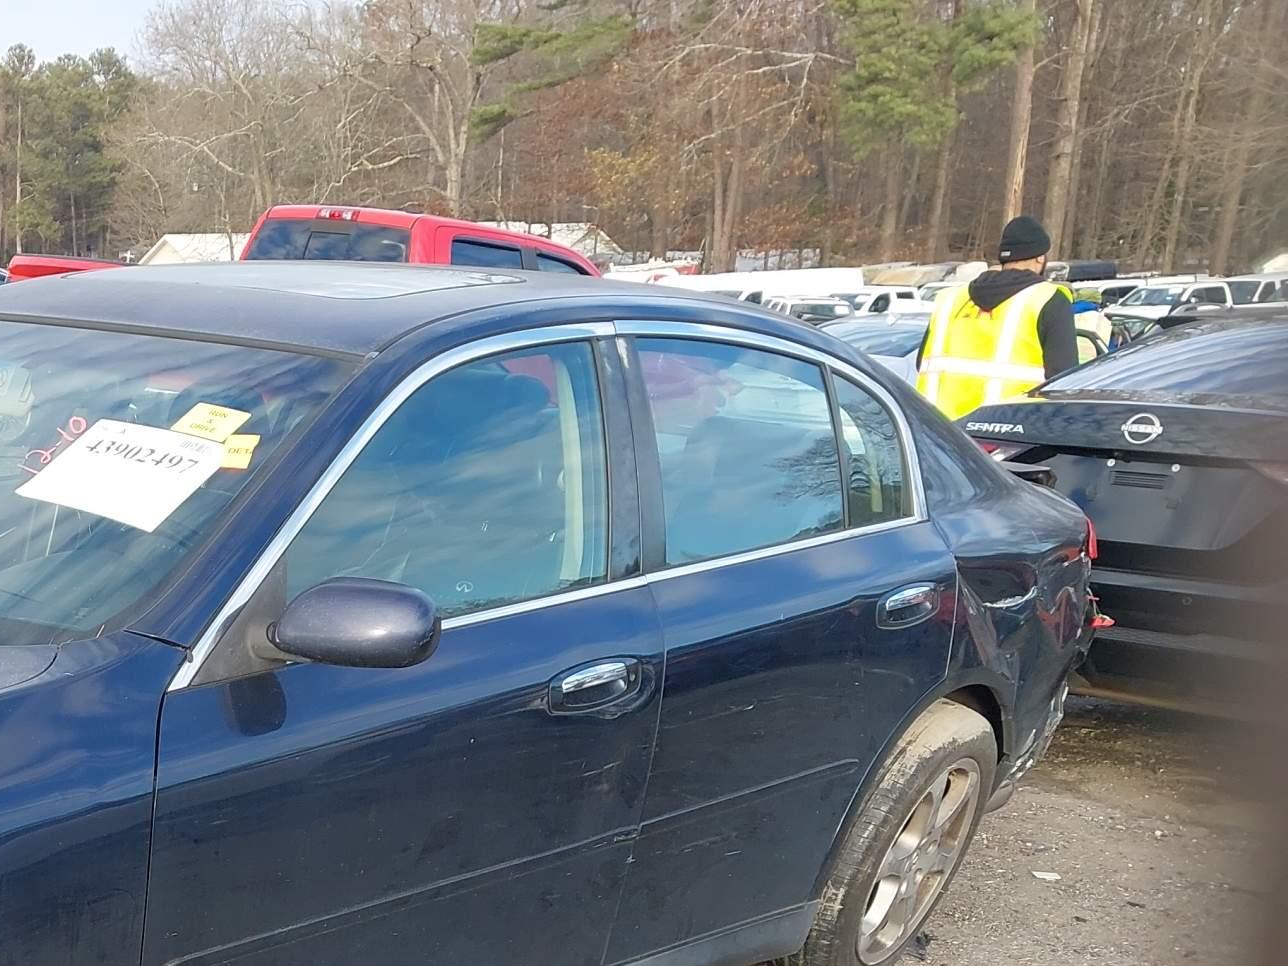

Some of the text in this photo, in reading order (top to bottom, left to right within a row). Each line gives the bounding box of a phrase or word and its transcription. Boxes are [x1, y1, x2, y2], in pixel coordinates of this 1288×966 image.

[208, 408, 229, 418] RUN
[189, 423, 217, 432] DRIVE
[965, 421, 1025, 434] SENTRA
[1120, 423, 1164, 435] NISSAN
[85, 439, 200, 474] 43902497
